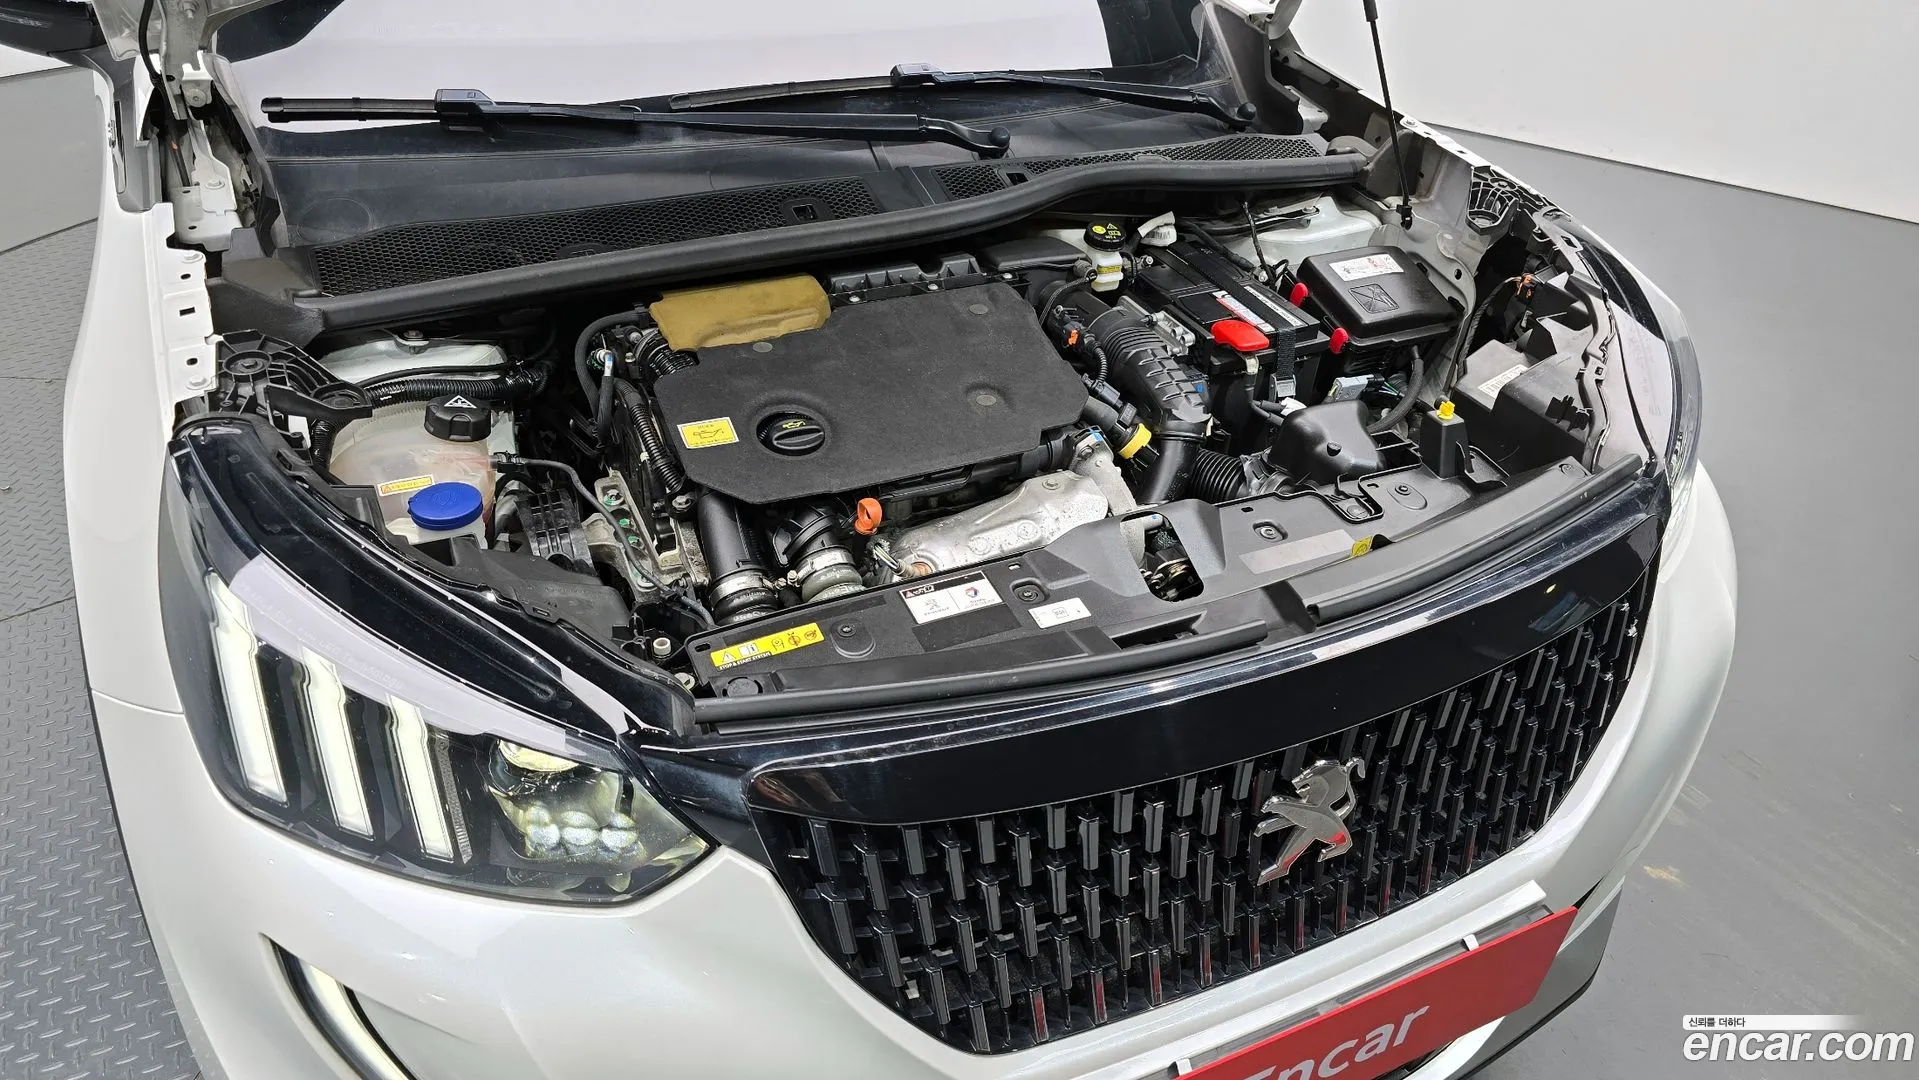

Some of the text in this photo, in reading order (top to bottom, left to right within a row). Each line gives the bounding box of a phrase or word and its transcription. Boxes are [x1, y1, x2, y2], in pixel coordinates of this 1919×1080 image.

[720, 662, 733, 670] STOP
[737, 658, 752, 666] START
[1244, 1005, 1430, 1080] ncar
